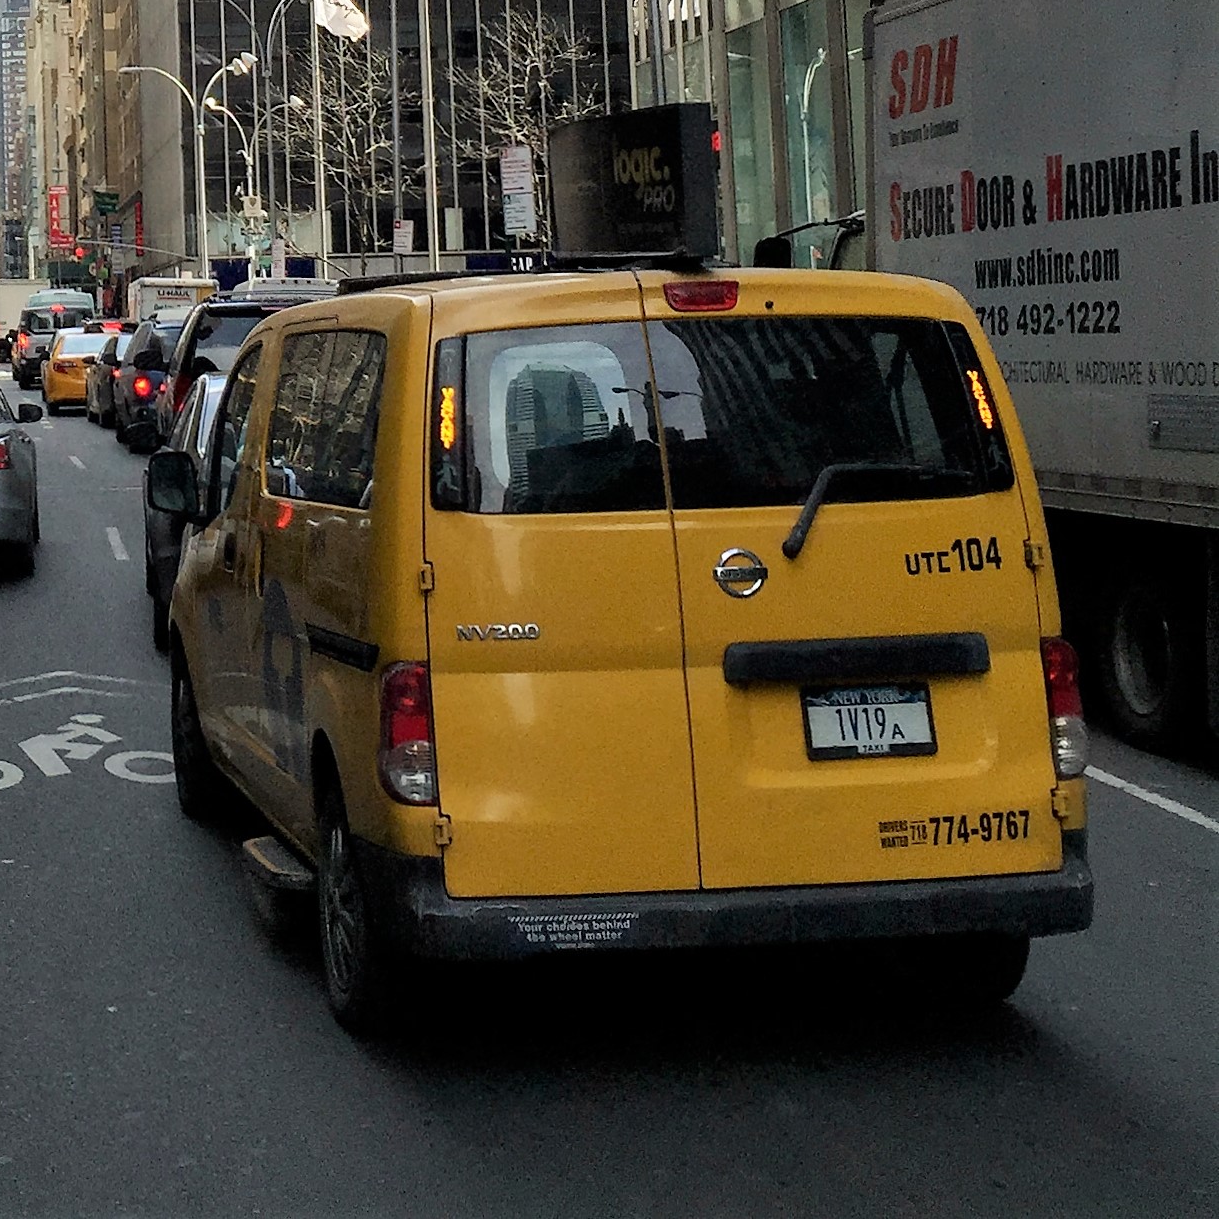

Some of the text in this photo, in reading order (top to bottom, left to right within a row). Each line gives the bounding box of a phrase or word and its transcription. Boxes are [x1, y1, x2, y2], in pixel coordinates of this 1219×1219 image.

[888, 33, 959, 119] SDH
[890, 181, 955, 241] SECURE
[960, 169, 1015, 232] DOOR
[1022, 179, 1037, 226] &
[1046, 147, 1182, 222] HARDWARE
[974, 247, 1120, 289] www.sdhinc.com
[976, 300, 1121, 336] 718 492-1222
[1077, 361, 1142, 385] HARDWARE
[1161, 361, 1207, 386] WOOD
[456, 623, 540, 641] NV200
[834, 690, 900, 705] NEW YORK
[862, 744, 885, 753] TAXI
[929, 810, 1030, 846] 774-9767
[518, 919, 630, 933] Your choices behind
[526, 931, 622, 942] the wheel matter
